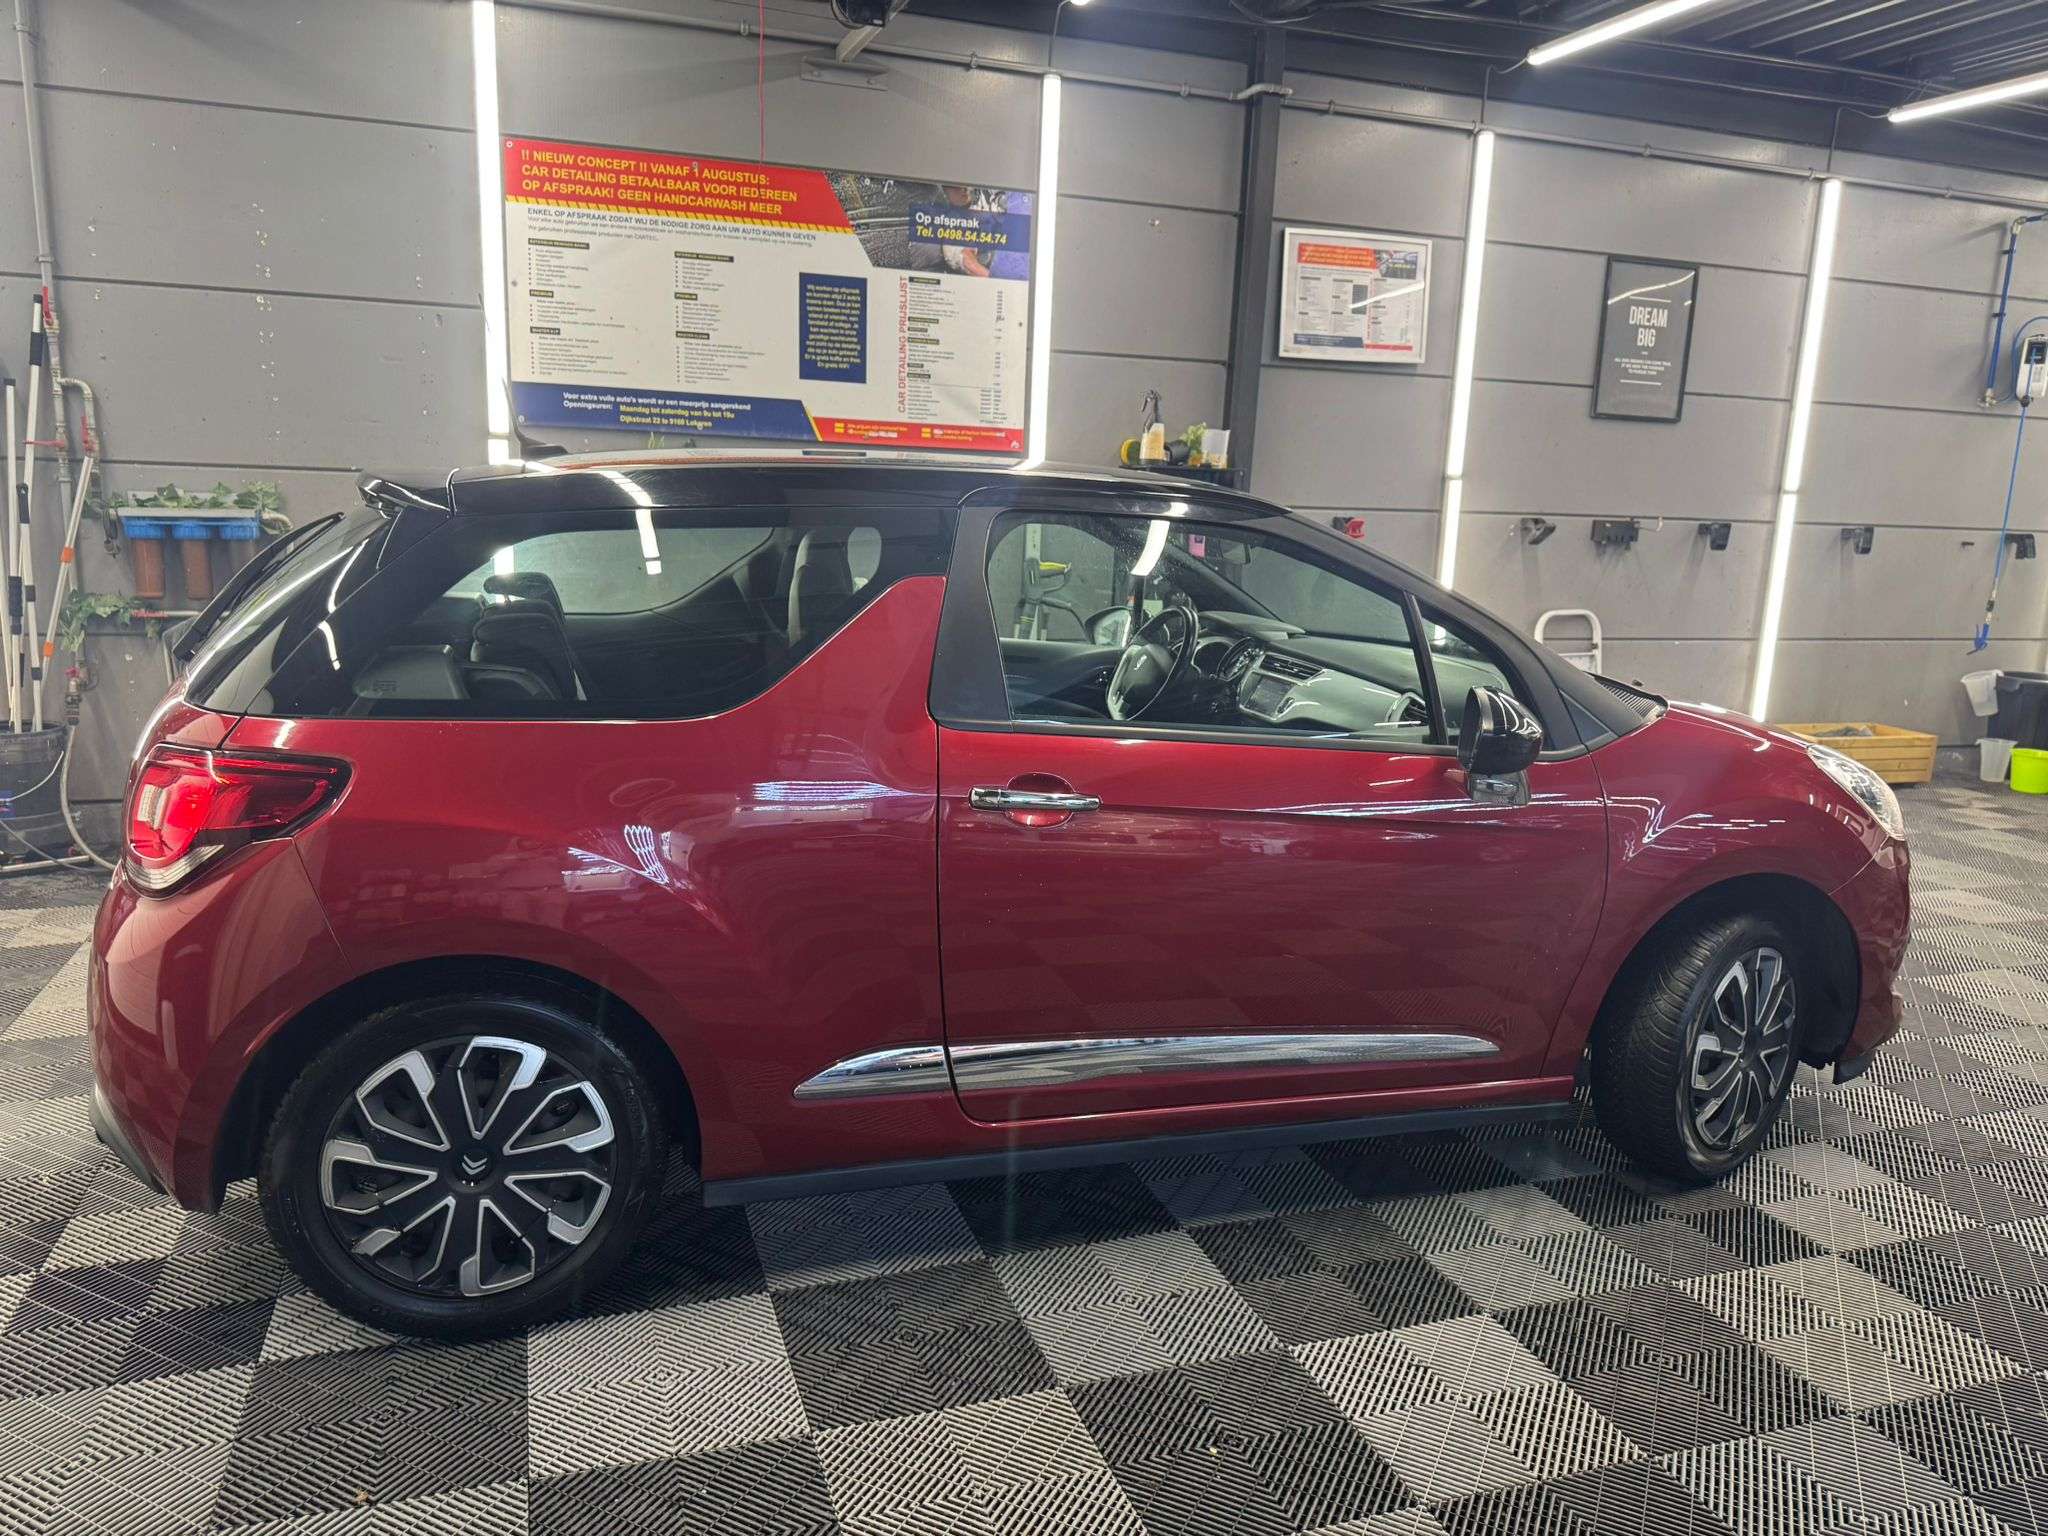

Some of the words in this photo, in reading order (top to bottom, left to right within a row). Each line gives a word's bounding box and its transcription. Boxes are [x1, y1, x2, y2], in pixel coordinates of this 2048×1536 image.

[522, 164, 549, 177] CAR
[552, 168, 616, 184] DETAILING
[619, 174, 700, 192] BETAALBAAR
[703, 184, 737, 196] VOOR
[739, 187, 798, 202] IEDEREEN
[533, 151, 574, 164] NIEUW
[577, 155, 636, 171] CONCEPT
[650, 163, 690, 177] VANAF
[702, 168, 770, 185] AUGUSTUS:
[522, 179, 541, 191] OP
[543, 181, 614, 198] AFSPRAAK!
[617, 189, 651, 202] GEEN
[654, 193, 746, 211] HANDCARWASH
[749, 202, 782, 215] MEER
[528, 208, 553, 217] ENKEL
[554, 209, 565, 218] OP
[566, 211, 607, 222] AFSPRAAK
[608, 215, 634, 224] ZODAT
[649, 218, 659, 226] DE
[690, 222, 711, 231] ZORG
[711, 224, 728, 233] AAN
[728, 225, 740, 233] UW
[741, 227, 761, 236] AUTO
[762, 229, 792, 238] KUNNEN
[792, 231, 817, 241] GEVEN
[915, 212, 931, 225] Op
[933, 214, 980, 229] afspraak
[915, 226, 934, 238] Tel.
[936, 228, 1008, 244] 0498.54.54.74
[899, 276, 908, 333] PRIJSLIJST
[1628, 306, 1669, 328] DREAM
[1636, 327, 1656, 347] BIG
[898, 335, 906, 389] DETAILING
[898, 394, 906, 413] CAR
